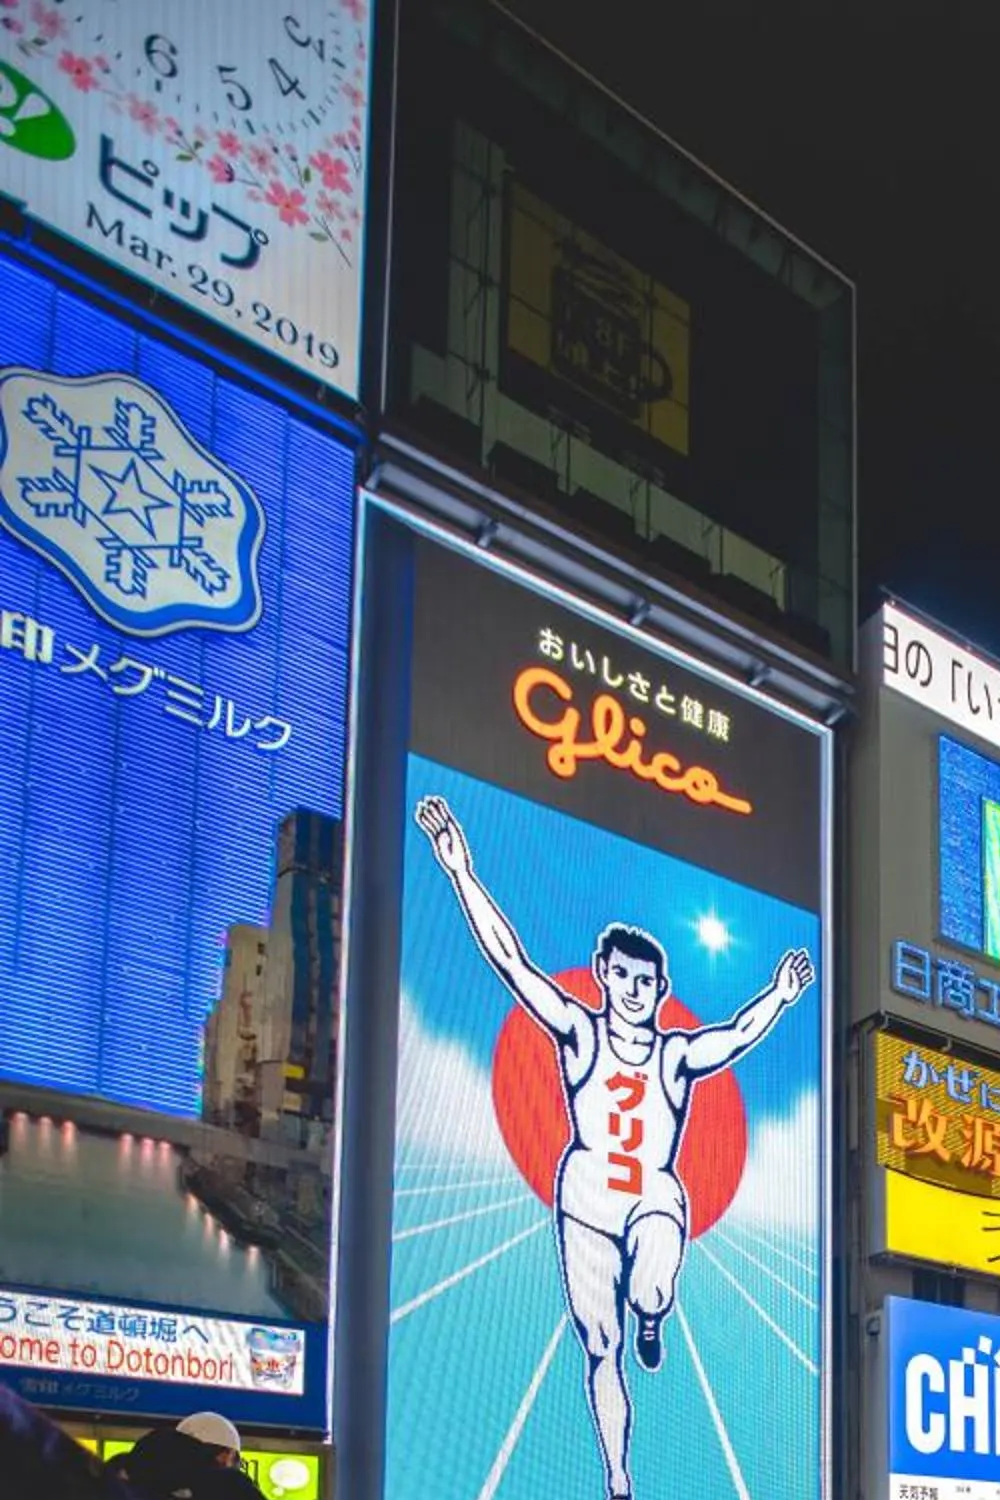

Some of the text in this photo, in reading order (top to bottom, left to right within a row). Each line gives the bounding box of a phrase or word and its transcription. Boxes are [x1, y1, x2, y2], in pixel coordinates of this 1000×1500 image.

[145, 34, 178, 79] 6
[216, 65, 253, 111] 5
[268, 57, 307, 100] 4
[99, 133, 270, 271] ピップ
[85, 202, 177, 278] Mar.
[252, 304, 340, 370] 2019
[1, 610, 293, 750] 印メグミルク
[537, 627, 732, 742] おいしさと健康
[605, 1070, 648, 1197] グリコ
[69, 1338, 98, 1367] to
[106, 1339, 234, 1381] Dotonbori
